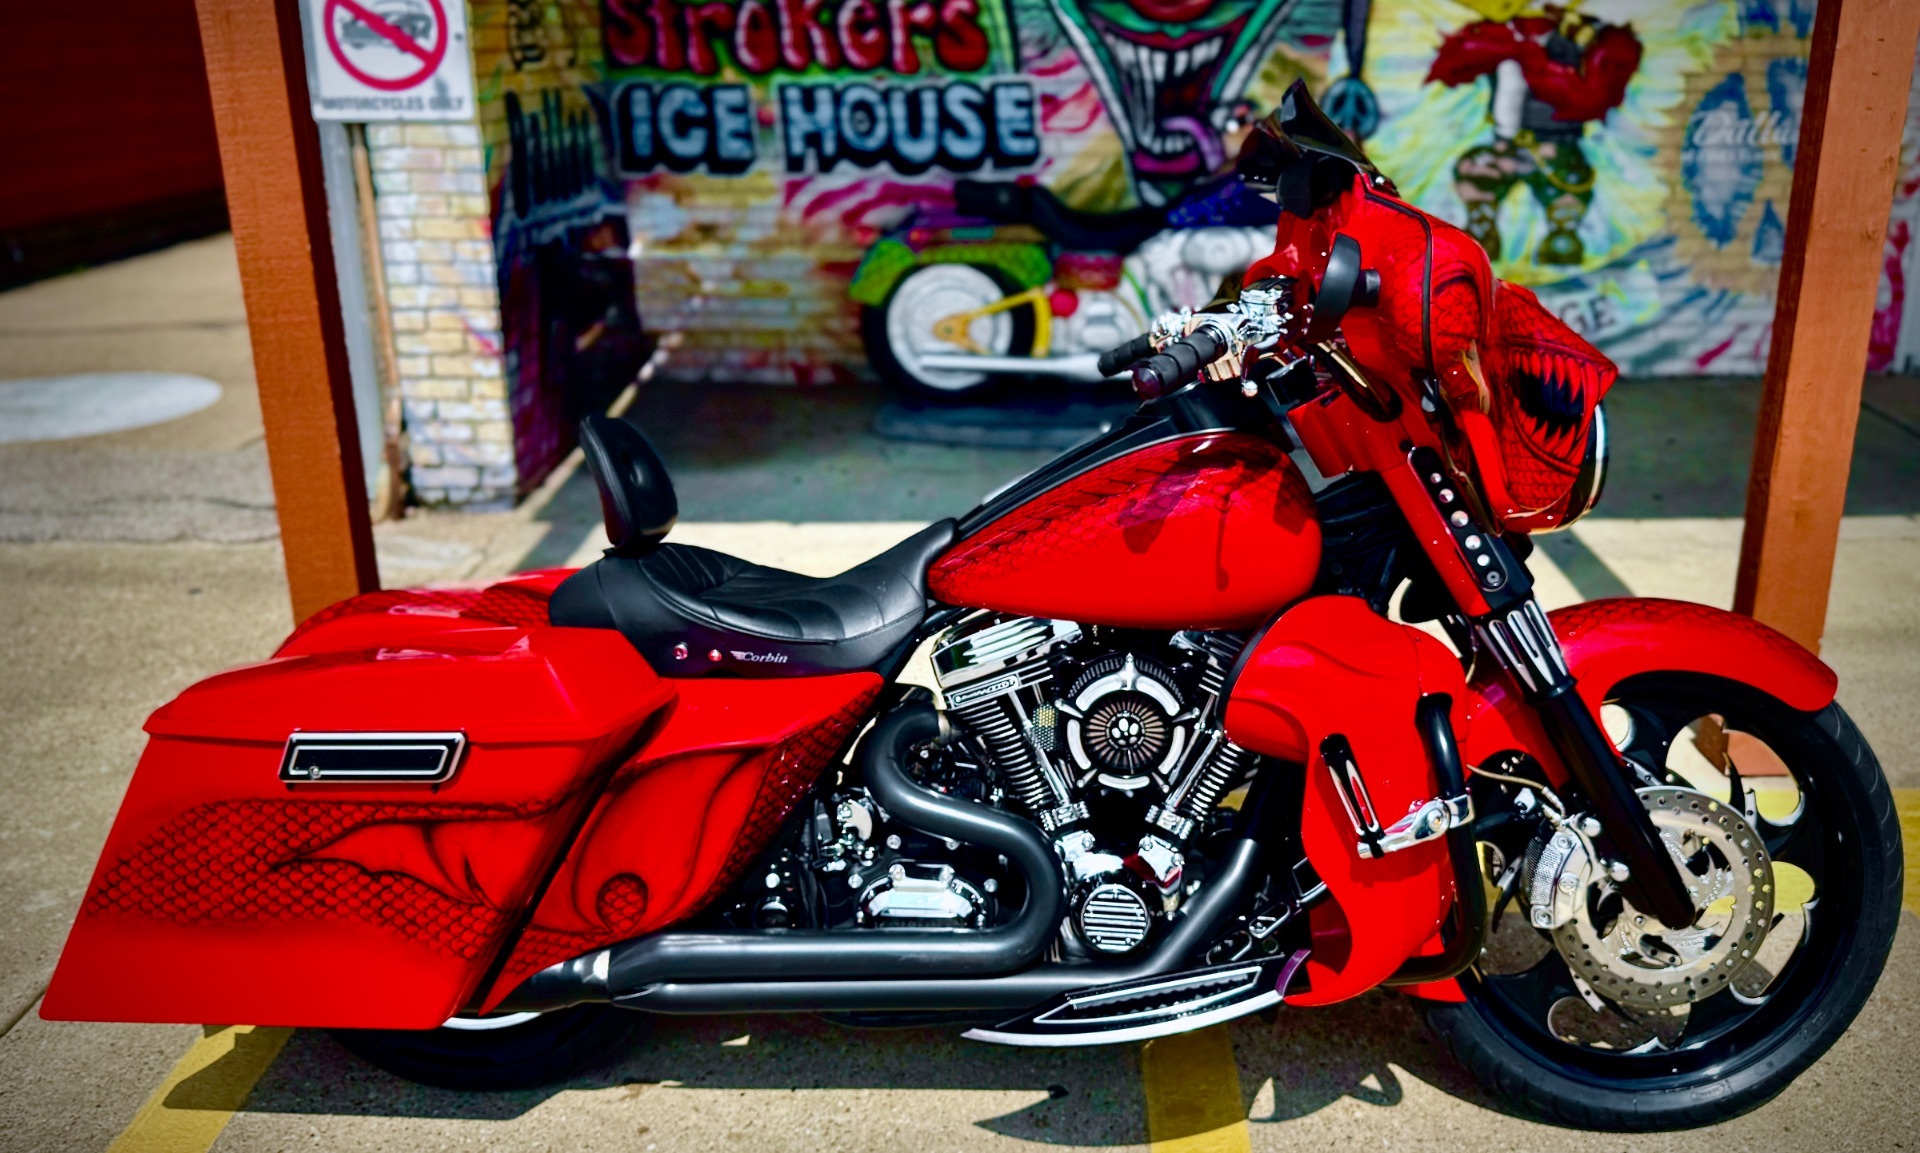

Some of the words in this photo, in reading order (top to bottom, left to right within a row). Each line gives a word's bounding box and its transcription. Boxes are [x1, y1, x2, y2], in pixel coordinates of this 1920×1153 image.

[321, 97, 424, 110] MOTORCYCLES
[621, 83, 755, 170] ICE
[780, 83, 1040, 171] HOUSE
[744, 651, 788, 663] Corbin
